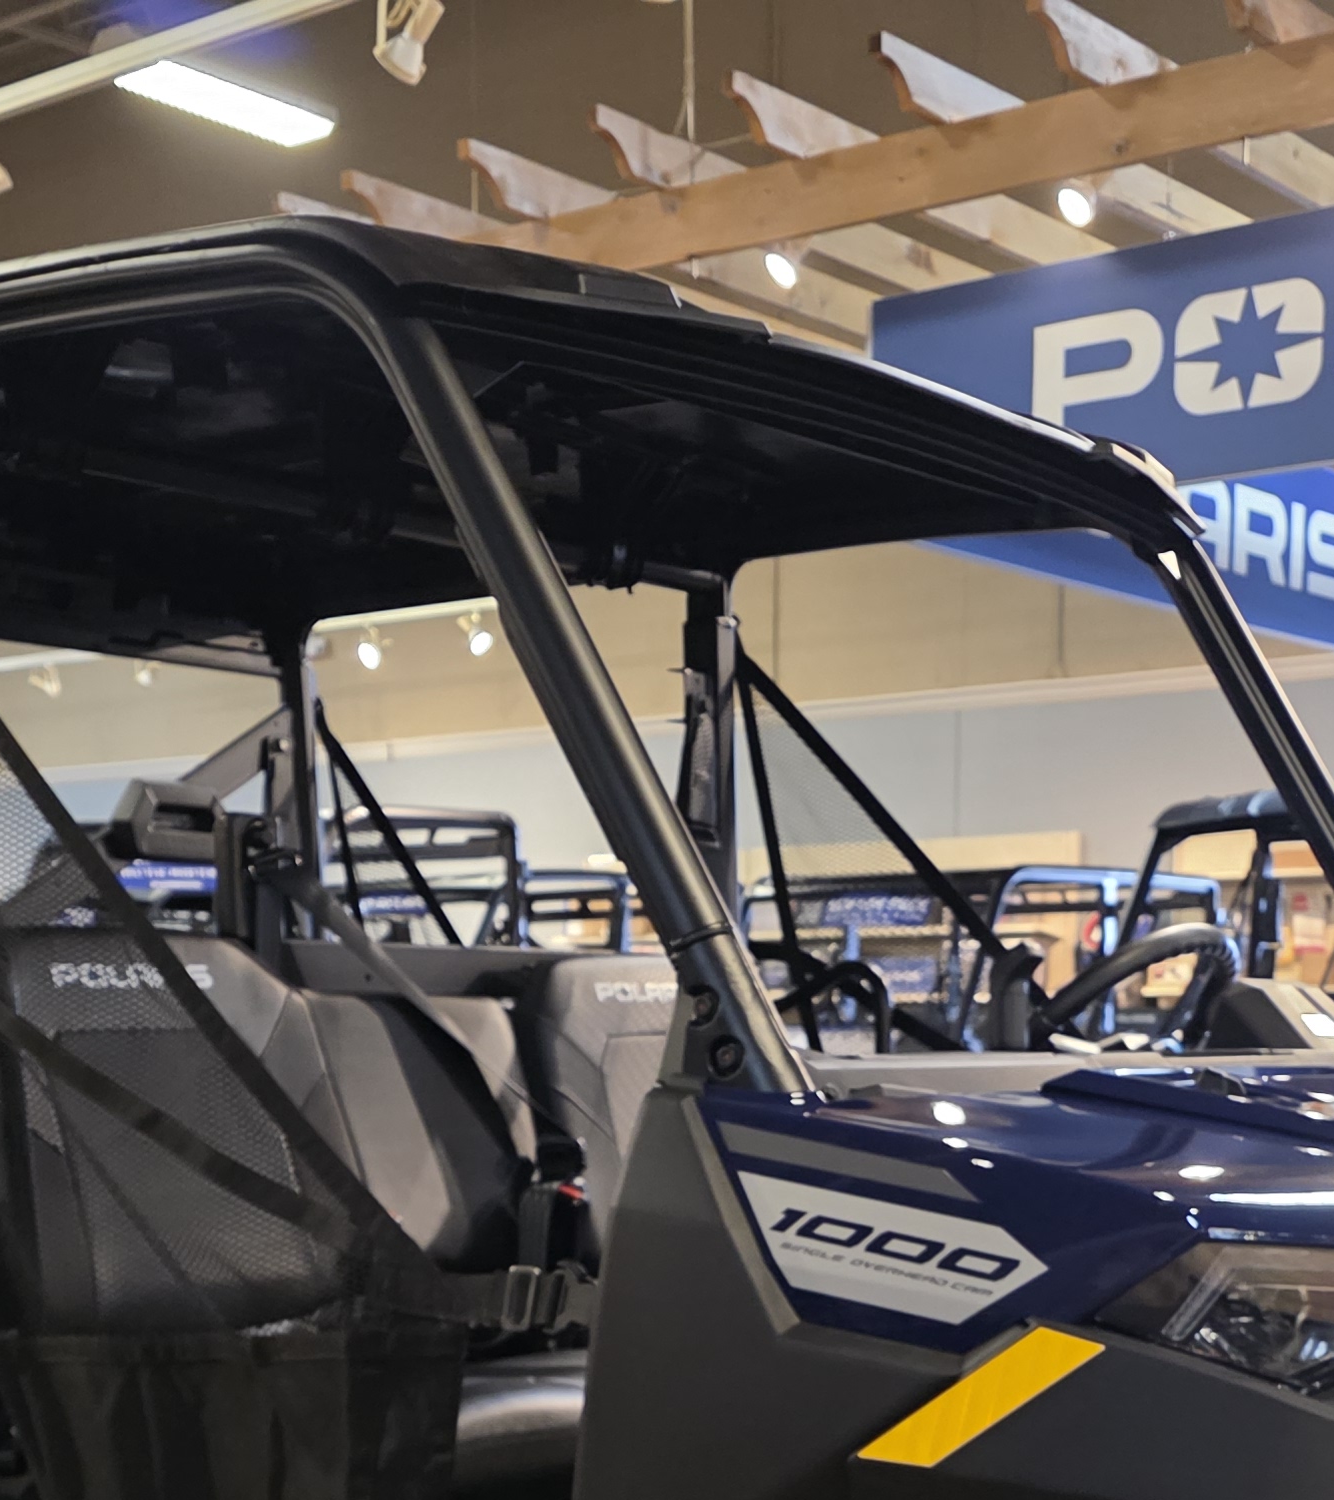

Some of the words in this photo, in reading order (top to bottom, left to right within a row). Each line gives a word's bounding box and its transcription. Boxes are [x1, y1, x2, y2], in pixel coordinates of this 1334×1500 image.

[594, 981, 679, 1003] POLAR
[769, 1207, 1021, 1282] 1000
[780, 1242, 845, 1262] SINGLE
[850, 1258, 949, 1287] OVERHEAD
[950, 1282, 994, 1296] CAM
